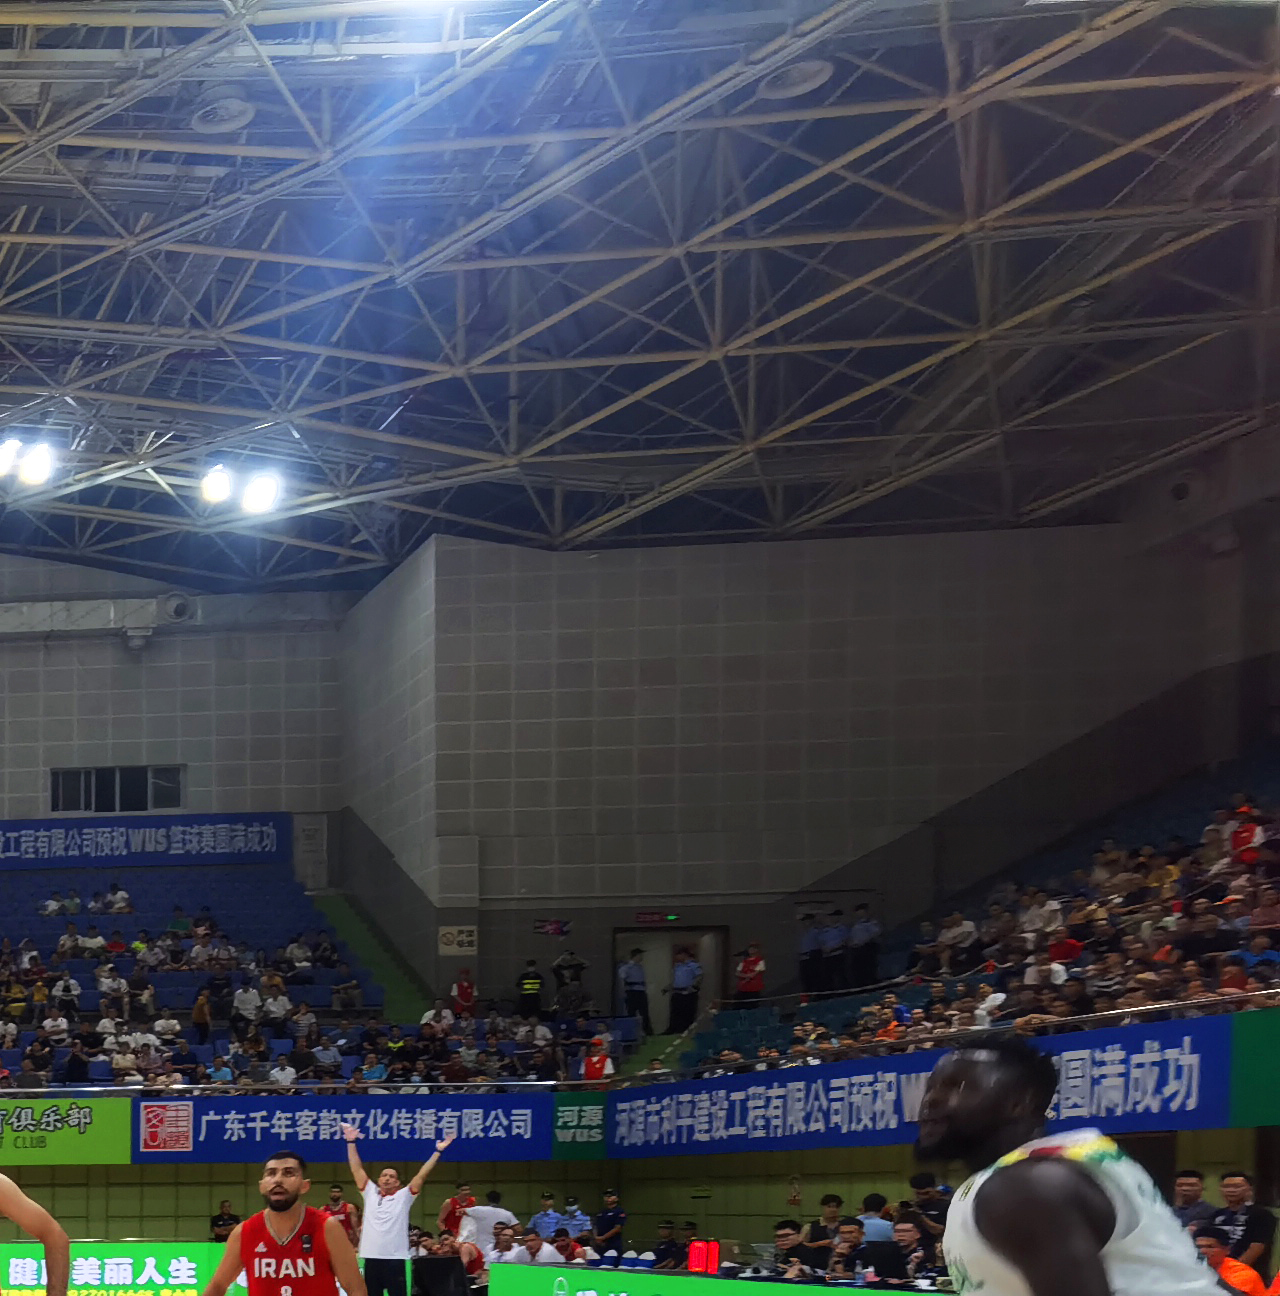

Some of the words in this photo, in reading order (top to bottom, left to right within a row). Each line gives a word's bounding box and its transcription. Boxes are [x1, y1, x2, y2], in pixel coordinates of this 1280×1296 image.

[556, 1105, 604, 1127] 河源
[13, 1135, 47, 1150] CLUB
[554, 1128, 604, 1143] WUS
[254, 1257, 315, 1279] IRAN
